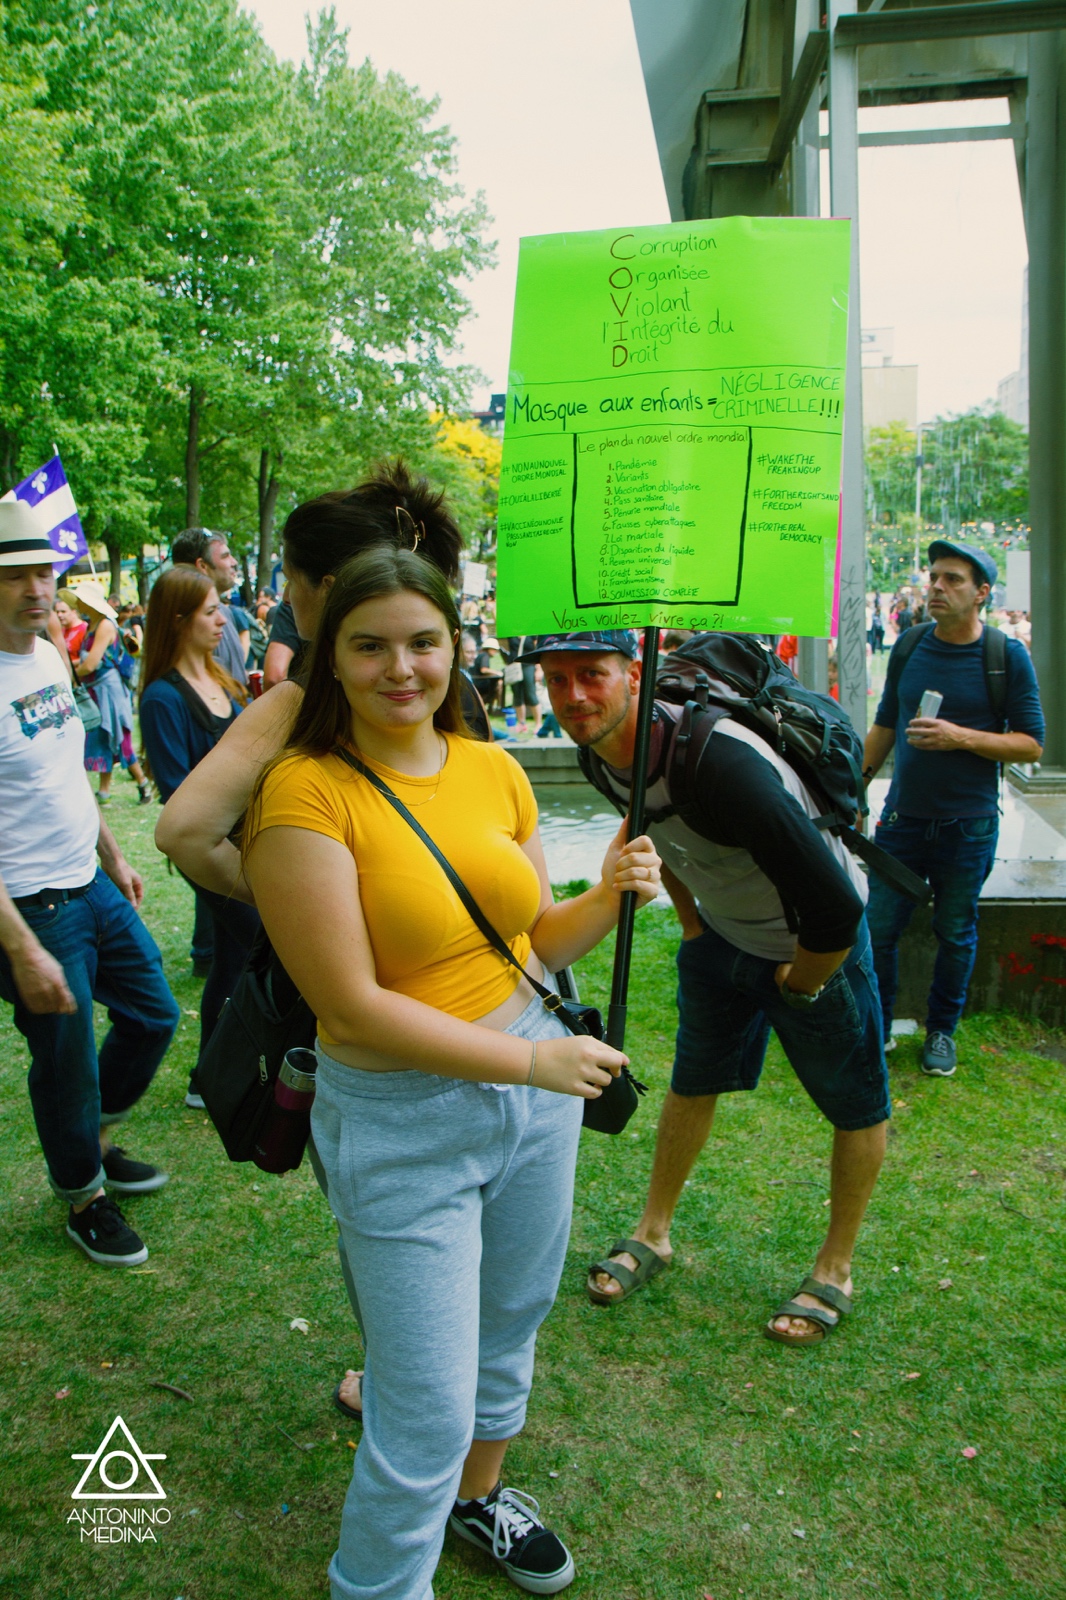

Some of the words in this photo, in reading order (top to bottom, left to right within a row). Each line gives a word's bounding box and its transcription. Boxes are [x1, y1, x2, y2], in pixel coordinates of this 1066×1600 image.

[610, 234, 717, 260] Corruption
[609, 265, 710, 290] Organisée
[610, 287, 692, 317] Violant
[708, 307, 735, 335] du
[612, 341, 659, 368] Droit
[721, 371, 841, 396] NÉGLIGENCE
[512, 393, 589, 431] Masque
[599, 396, 634, 413] aux
[640, 387, 703, 413] enfants
[578, 436, 596, 454] Le
[599, 438, 620, 456] plan
[621, 433, 634, 447] du
[637, 431, 672, 445] nouvel
[676, 431, 703, 444] ordre
[707, 431, 748, 443] mondial
[615, 458, 658, 471] Pandémie
[756, 453, 816, 467] #WAKETHE
[615, 471, 650, 483] Variants
[767, 465, 822, 475] FREAKINGUP
[614, 483, 657, 495] Vaccination
[658, 480, 701, 495] obligatoire
[613, 495, 631, 506] Pass
[634, 493, 664, 503] sanitaire
[762, 501, 803, 511] FREEDOM
[644, 502, 680, 512] mondiale
[612, 519, 641, 530] Fausses
[610, 534, 623, 544] Loi
[626, 528, 664, 541] martiale
[780, 533, 823, 545] DEMOCRACY
[610, 544, 653, 557] Disparition
[655, 542, 665, 552] du
[668, 543, 695, 557] liquide
[609, 557, 635, 566] Revenu
[638, 555, 672, 566] universel
[635, 566, 654, 576] social
[610, 588, 661, 600] SOUMISSION
[552, 609, 588, 630] Vous
[595, 605, 641, 625] voulez
[649, 611, 684, 624] vivre
